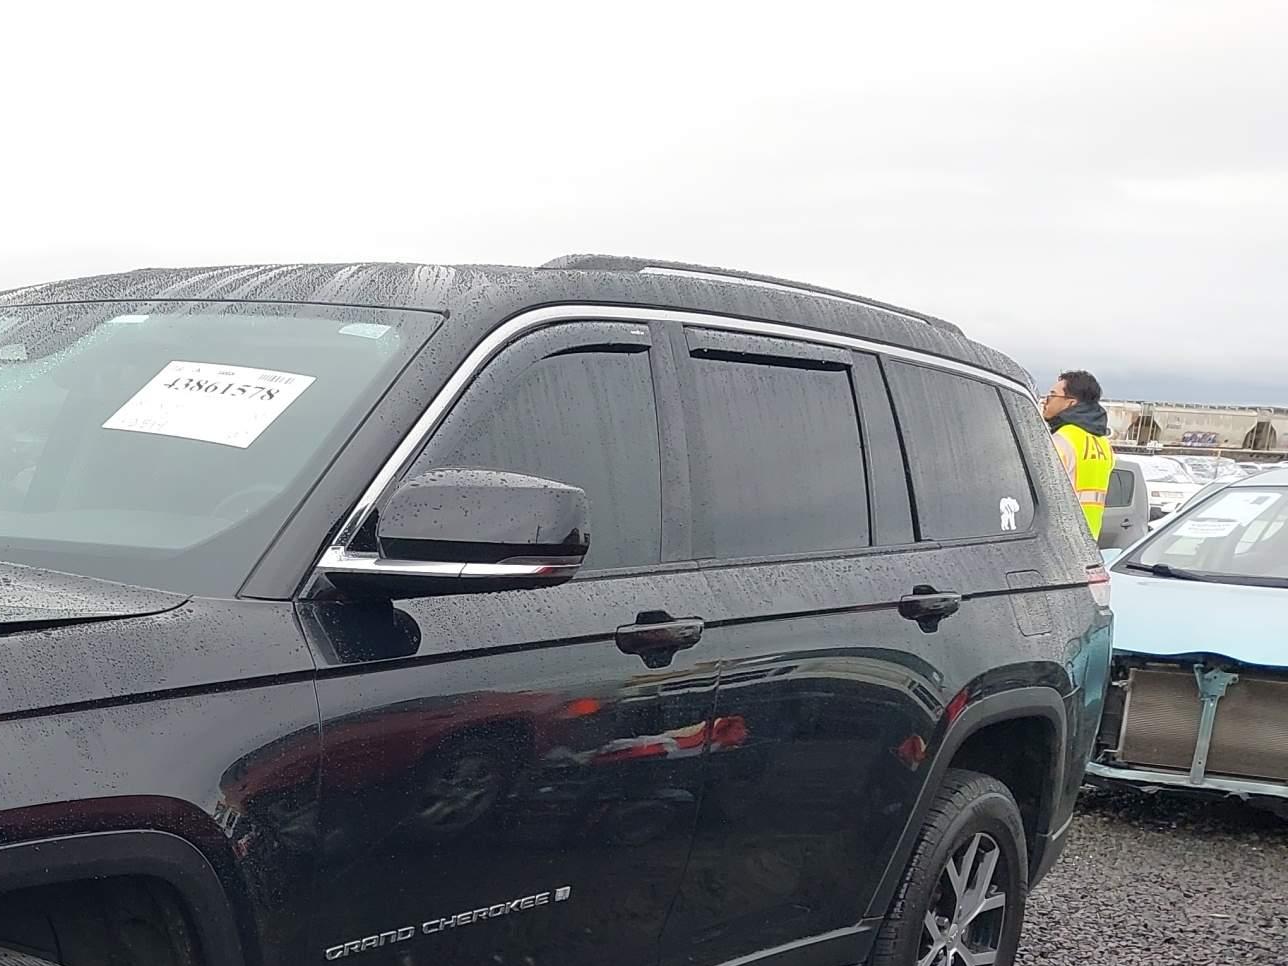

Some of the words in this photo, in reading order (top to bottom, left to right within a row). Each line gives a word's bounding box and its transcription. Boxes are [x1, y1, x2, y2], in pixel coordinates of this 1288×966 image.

[163, 377, 280, 401] 43861578
[325, 925, 415, 961] GRAND
[422, 891, 551, 935] CHEROKEE
